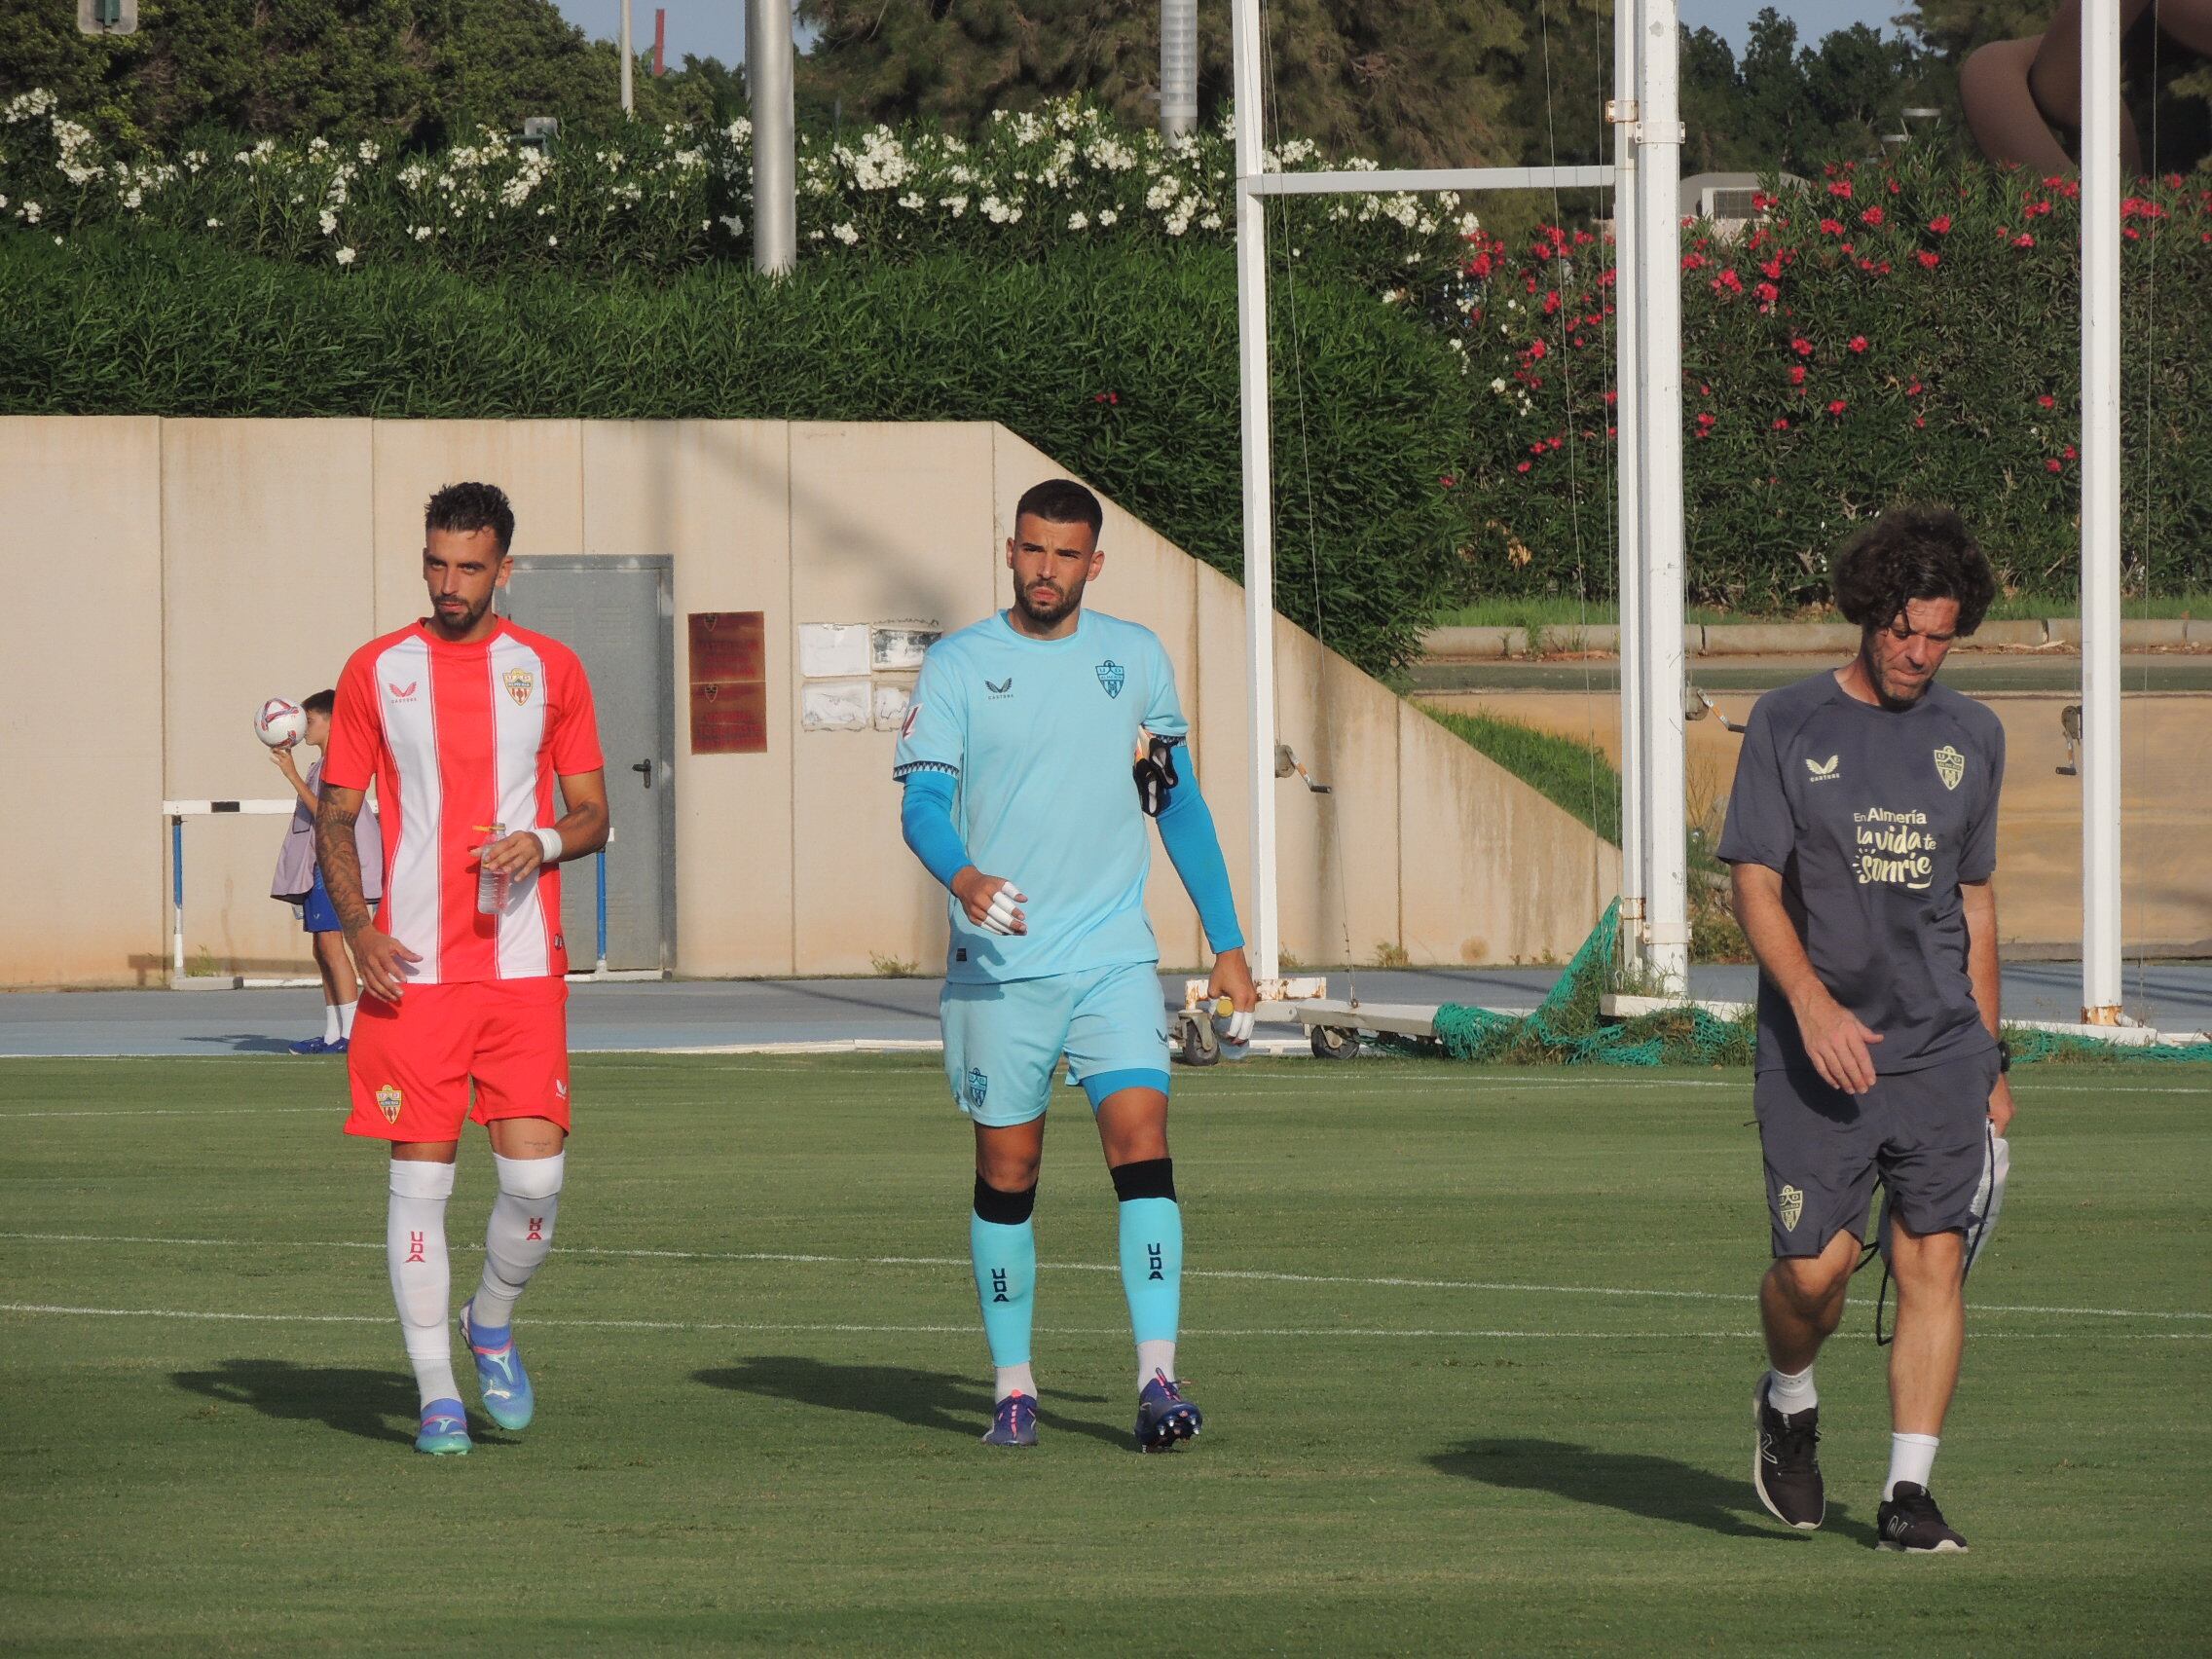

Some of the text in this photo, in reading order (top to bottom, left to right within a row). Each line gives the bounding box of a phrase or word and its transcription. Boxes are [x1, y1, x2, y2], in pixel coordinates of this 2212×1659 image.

[1853, 807, 1928, 825] En Almería
[1857, 825, 1937, 855] la vida te
